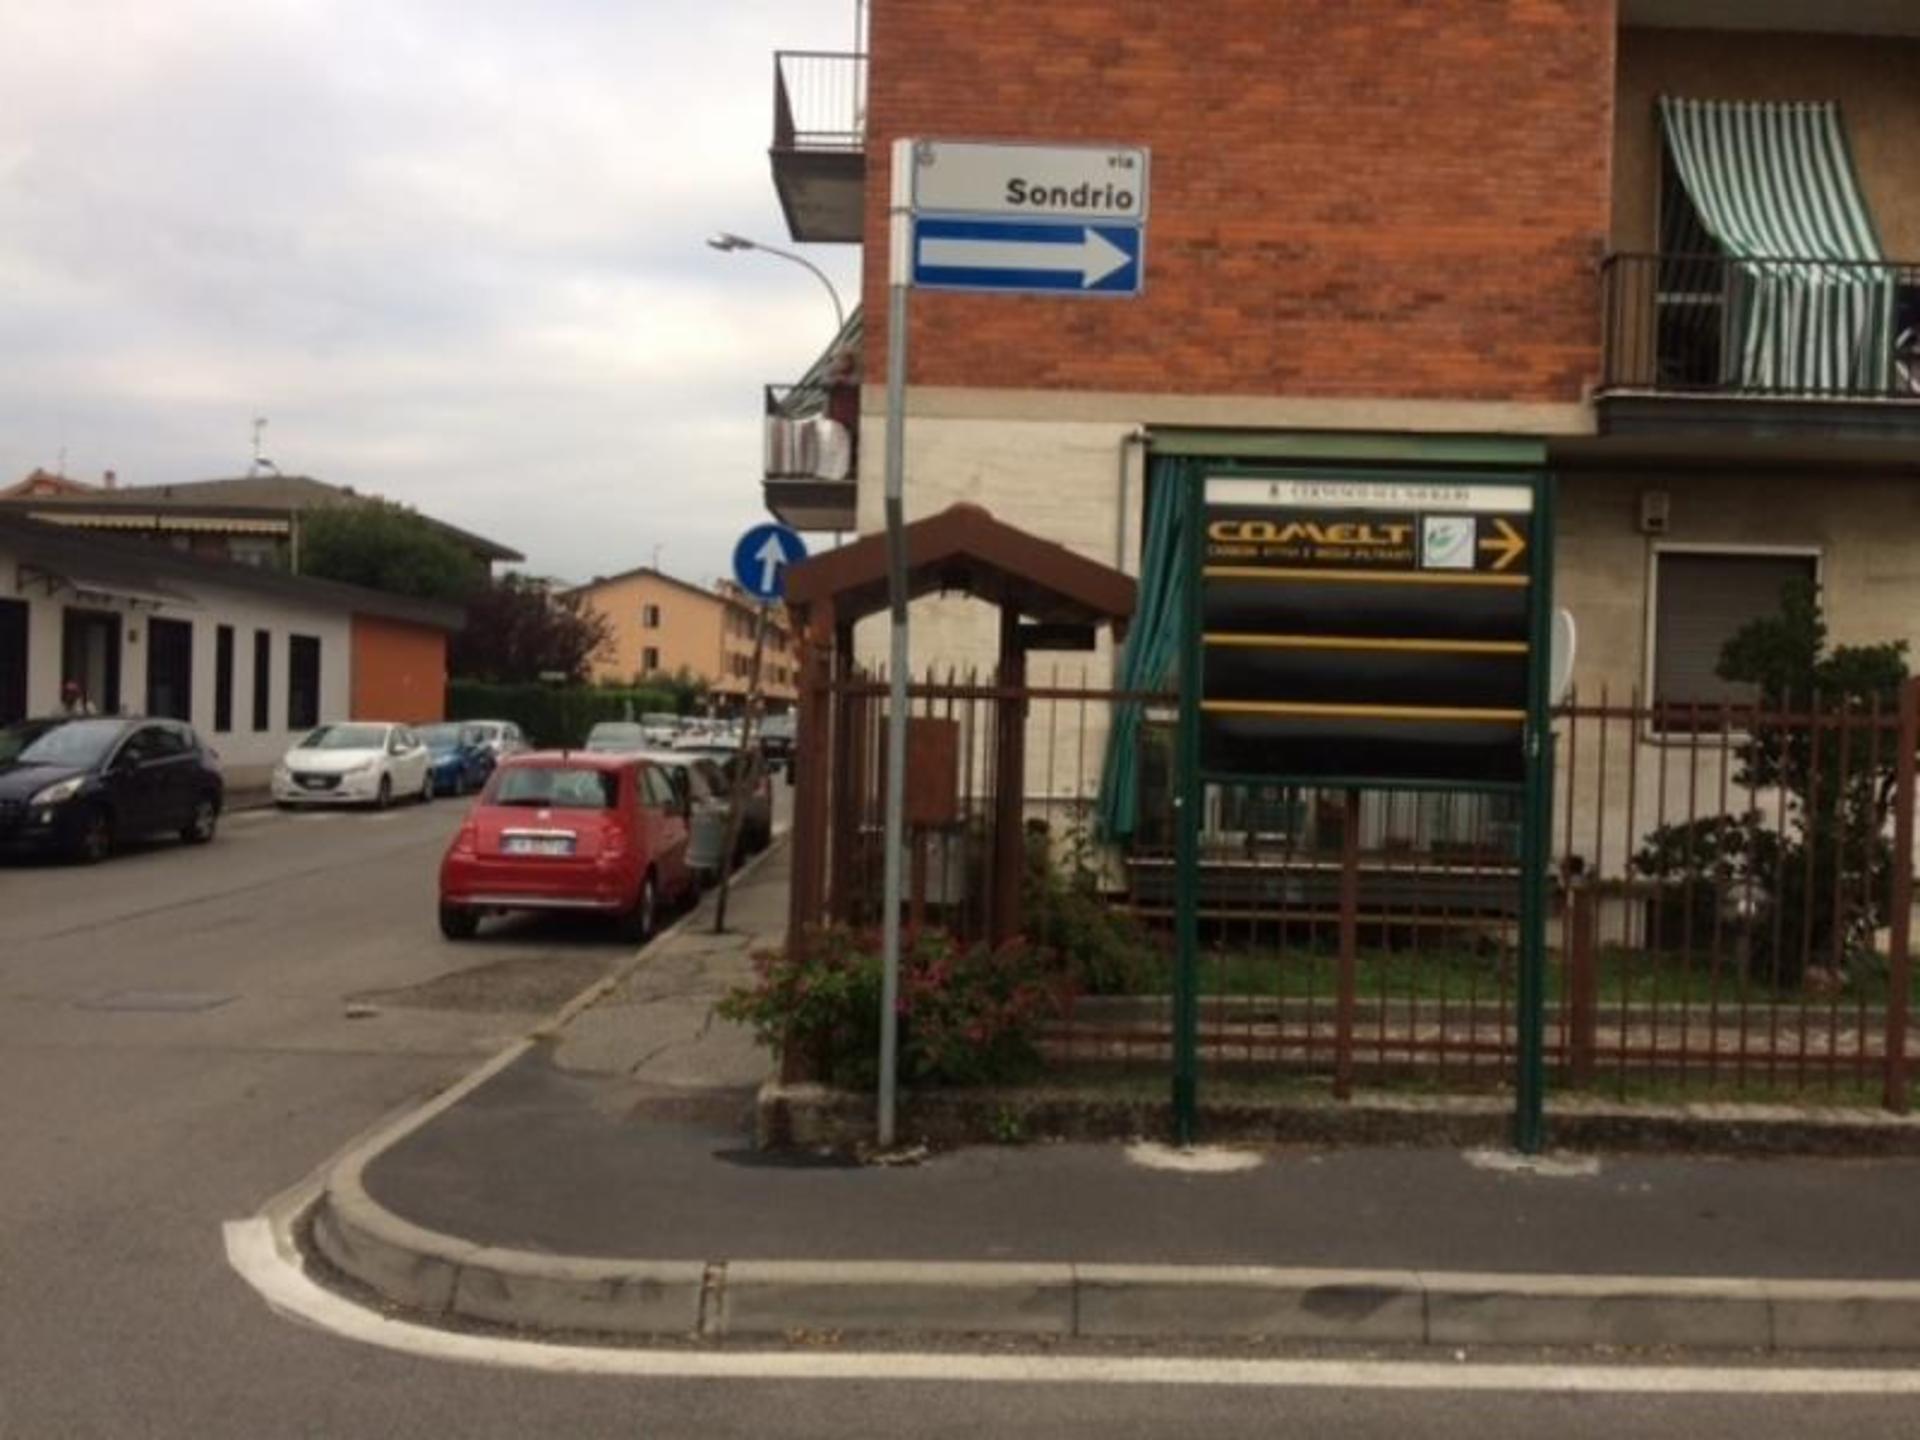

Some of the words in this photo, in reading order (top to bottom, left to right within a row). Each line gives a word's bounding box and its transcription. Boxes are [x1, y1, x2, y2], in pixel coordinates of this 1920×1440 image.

[1107, 154, 1134, 169] via
[1005, 178, 1134, 210] Sondrio
[1207, 520, 1412, 545] COMELT
